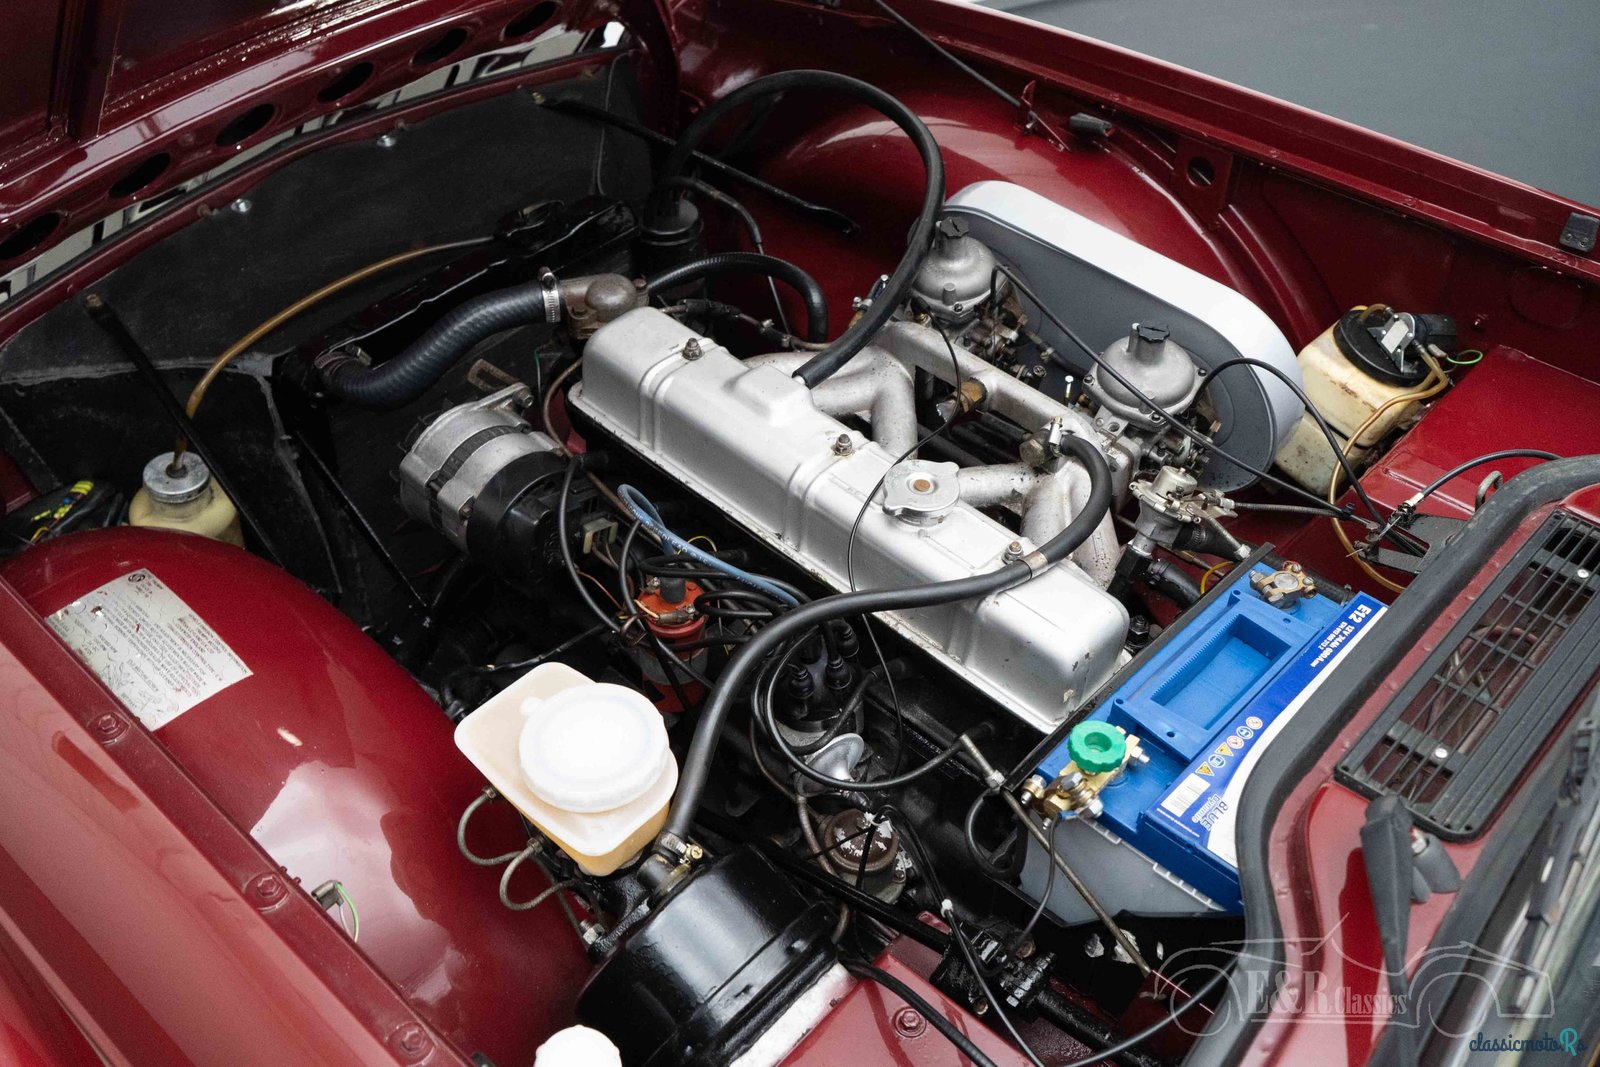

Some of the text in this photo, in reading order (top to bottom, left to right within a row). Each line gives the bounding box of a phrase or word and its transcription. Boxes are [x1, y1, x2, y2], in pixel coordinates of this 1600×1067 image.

[1348, 604, 1372, 623] E12
[1342, 625, 1354, 636] 12V
[1201, 801, 1229, 831] BLUE
